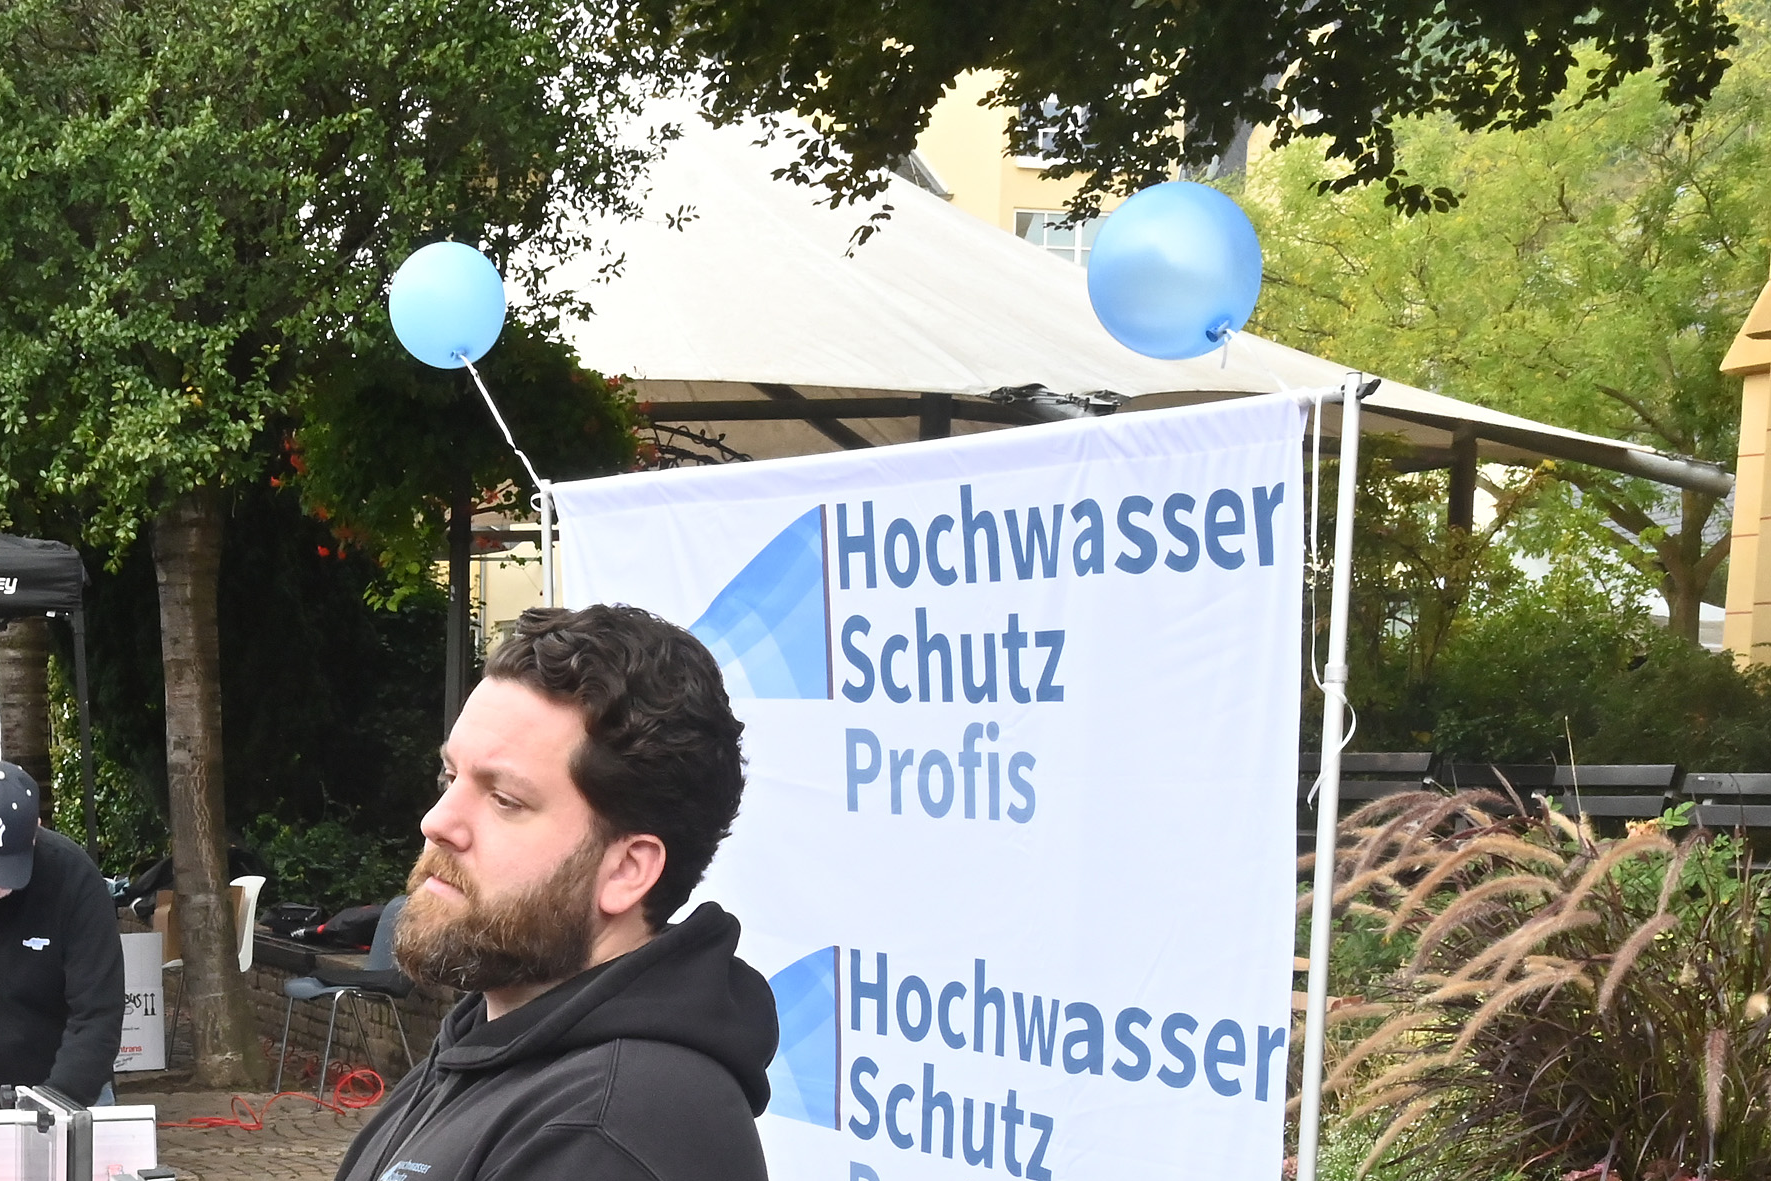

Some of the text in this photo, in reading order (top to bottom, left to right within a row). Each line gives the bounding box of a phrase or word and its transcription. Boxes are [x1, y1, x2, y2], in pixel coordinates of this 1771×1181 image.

[836, 482, 1285, 590] Hochwasser
[841, 607, 1065, 704] Schutz
[845, 721, 1036, 824] Profis
[850, 948, 1286, 1102] Hochwasser
